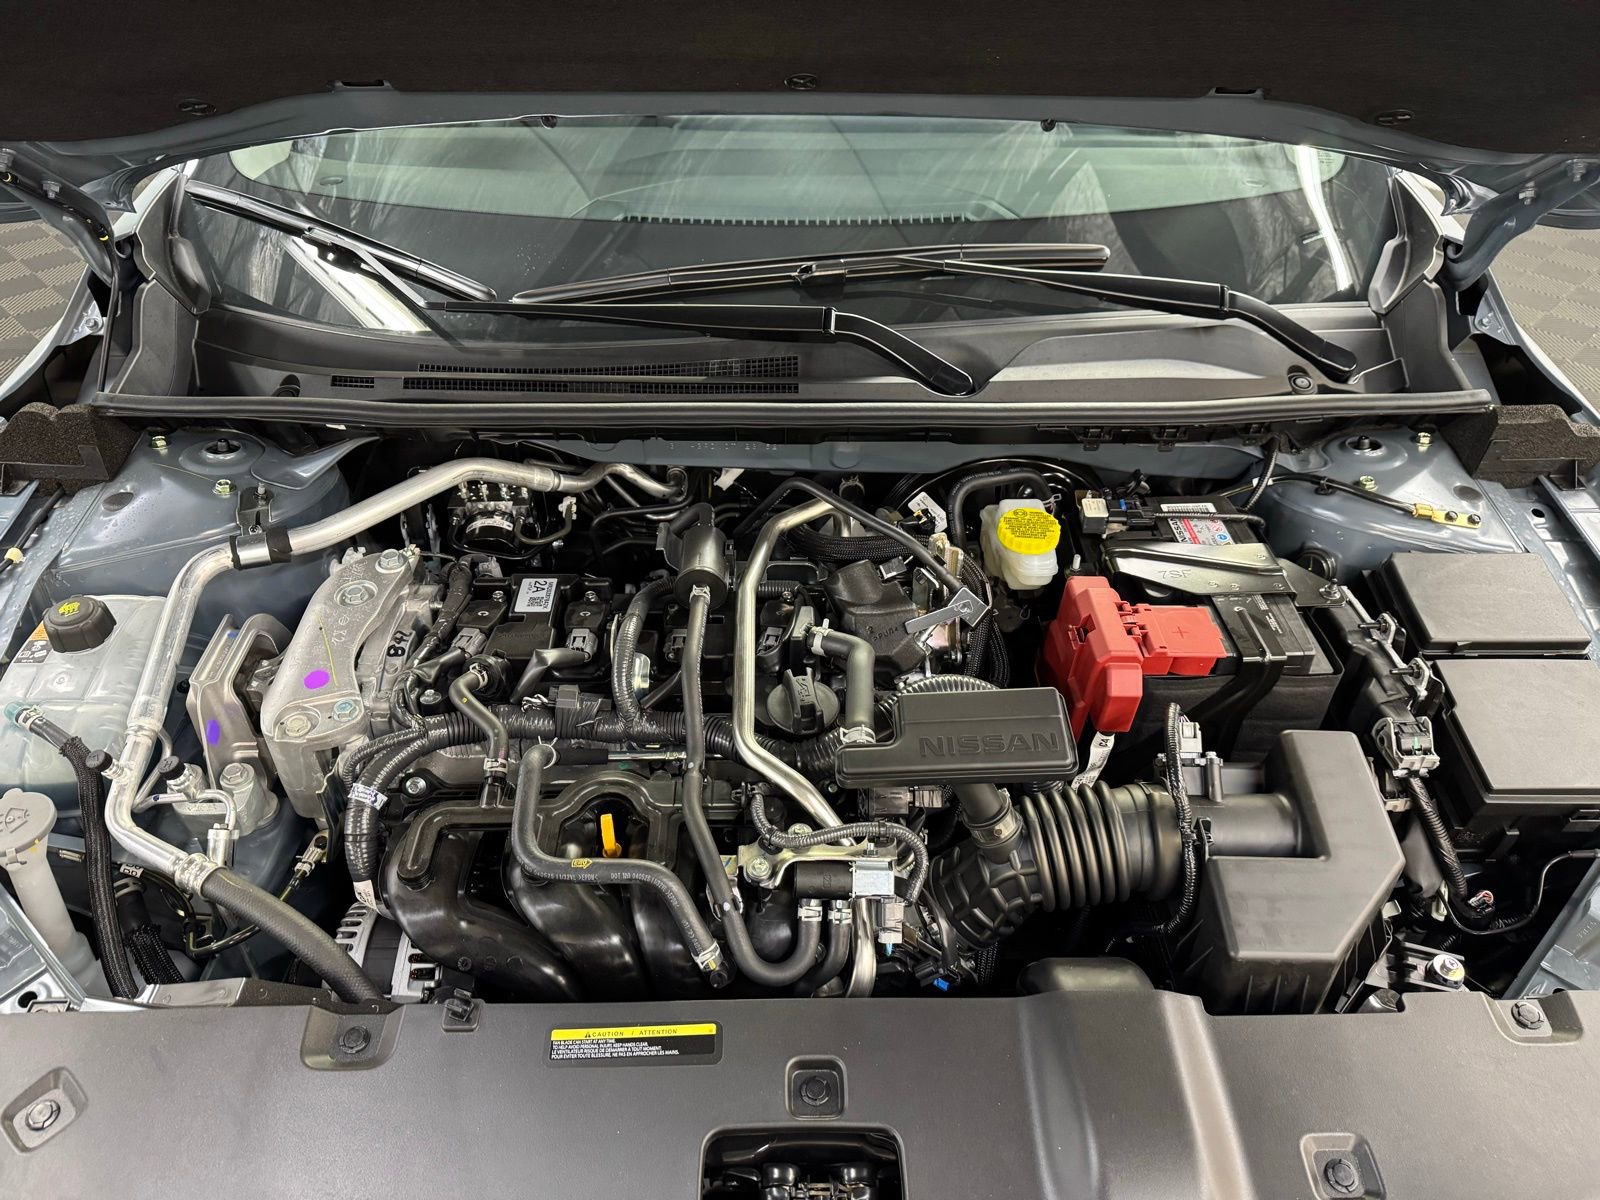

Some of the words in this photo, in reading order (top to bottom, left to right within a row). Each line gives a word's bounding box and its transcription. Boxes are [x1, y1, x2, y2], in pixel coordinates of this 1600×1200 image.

[531, 580, 548, 593] 2A
[919, 732, 1060, 758] NISSAN
[639, 1028, 678, 1036] ATTENTION
